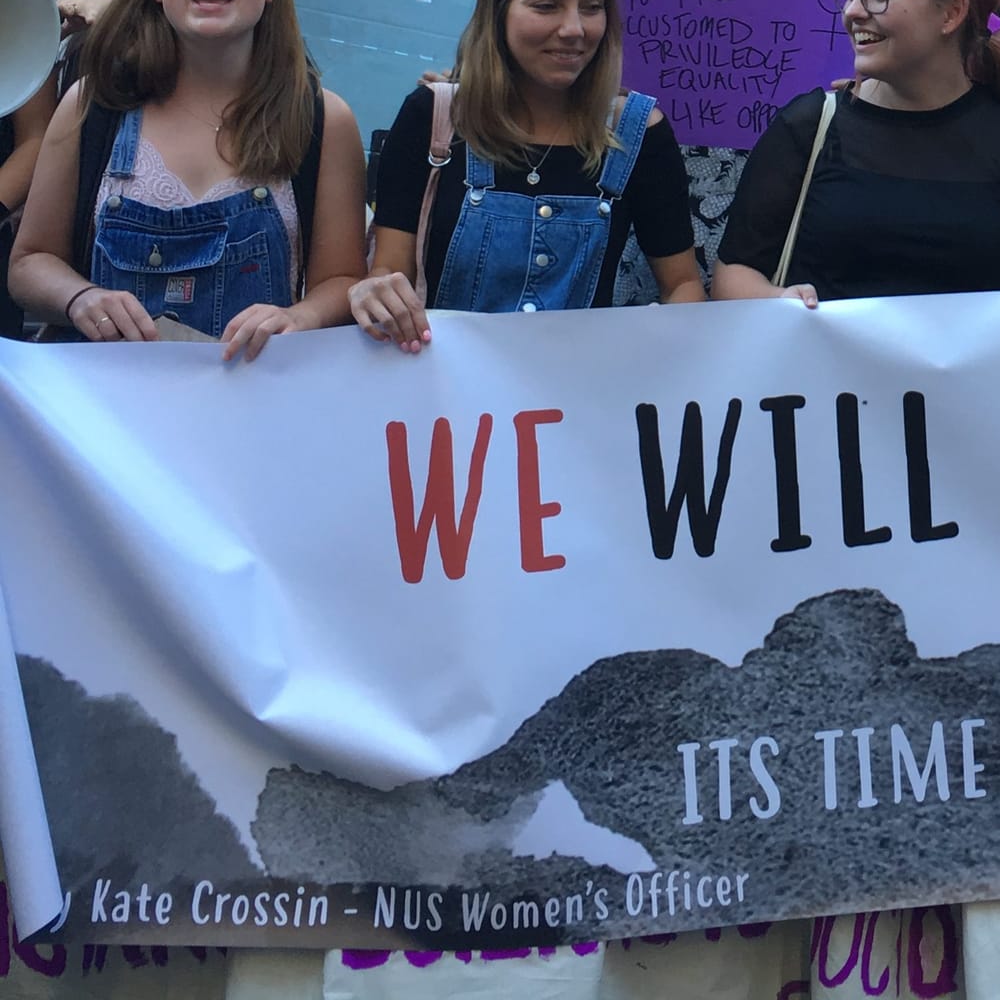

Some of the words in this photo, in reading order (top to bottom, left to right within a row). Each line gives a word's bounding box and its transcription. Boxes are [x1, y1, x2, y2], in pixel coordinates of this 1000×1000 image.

[770, 20, 797, 45] TO
[638, 39, 803, 76] PRIVILEDGE
[659, 65, 783, 99] EQUALITY
[671, 98, 728, 130] LIKE
[386, 408, 566, 584] WE
[635, 390, 960, 560] WILL
[677, 735, 783, 825] ITS
[814, 717, 989, 811] TIME
[91, 878, 173, 926] Kate
[191, 879, 329, 928] Crossin
[373, 885, 444, 932] NUS
[462, 879, 610, 933] Women's
[626, 870, 751, 919] Officer
